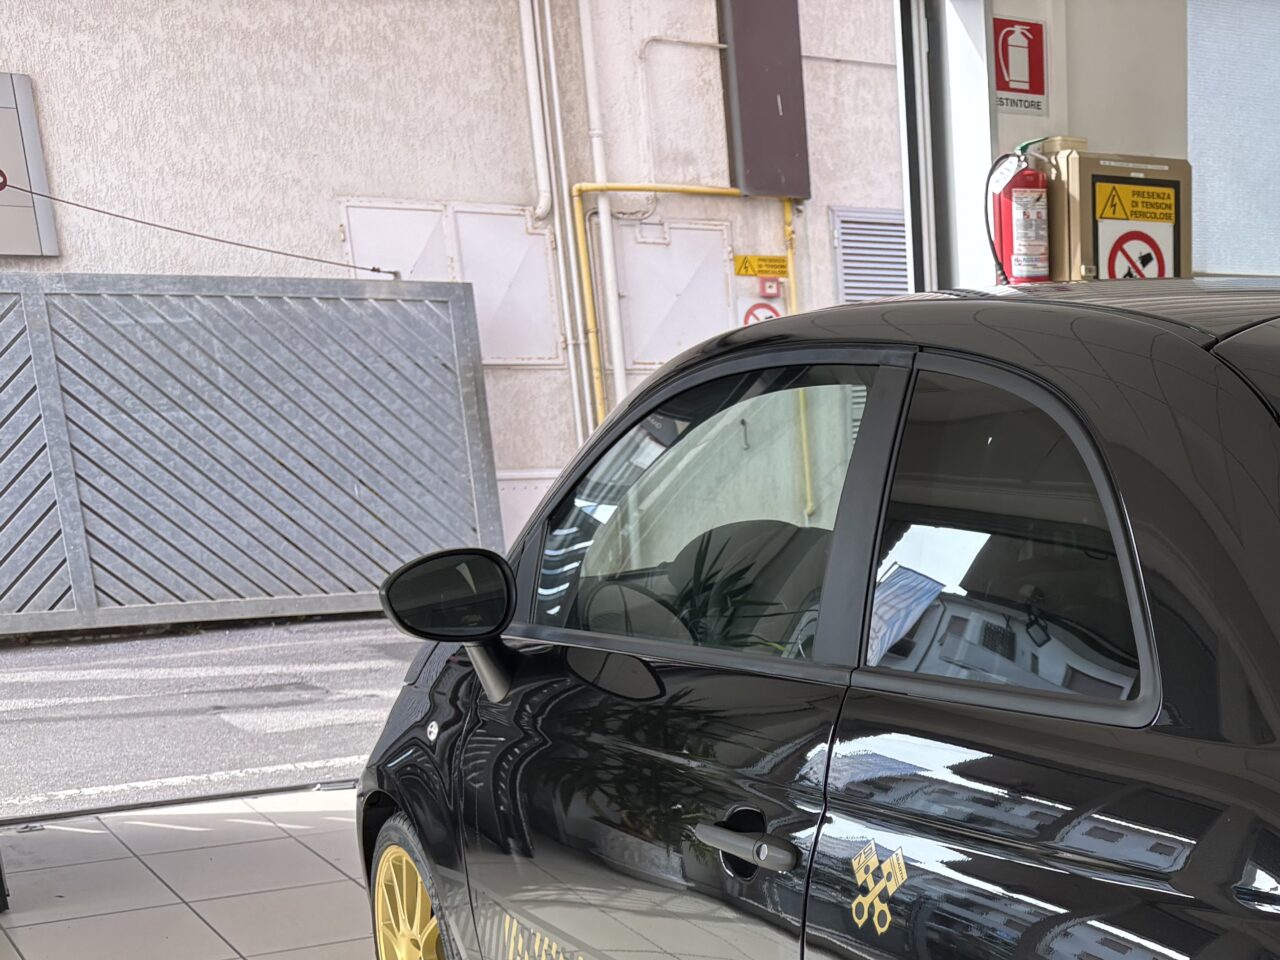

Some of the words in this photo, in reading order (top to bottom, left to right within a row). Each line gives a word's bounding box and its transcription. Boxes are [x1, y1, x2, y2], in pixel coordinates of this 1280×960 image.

[1131, 190, 1171, 200] PRESENZA
[1131, 200, 1139, 208] DI
[1141, 201, 1172, 210] TENSIONI
[1130, 210, 1174, 220] PERICOLOSE
